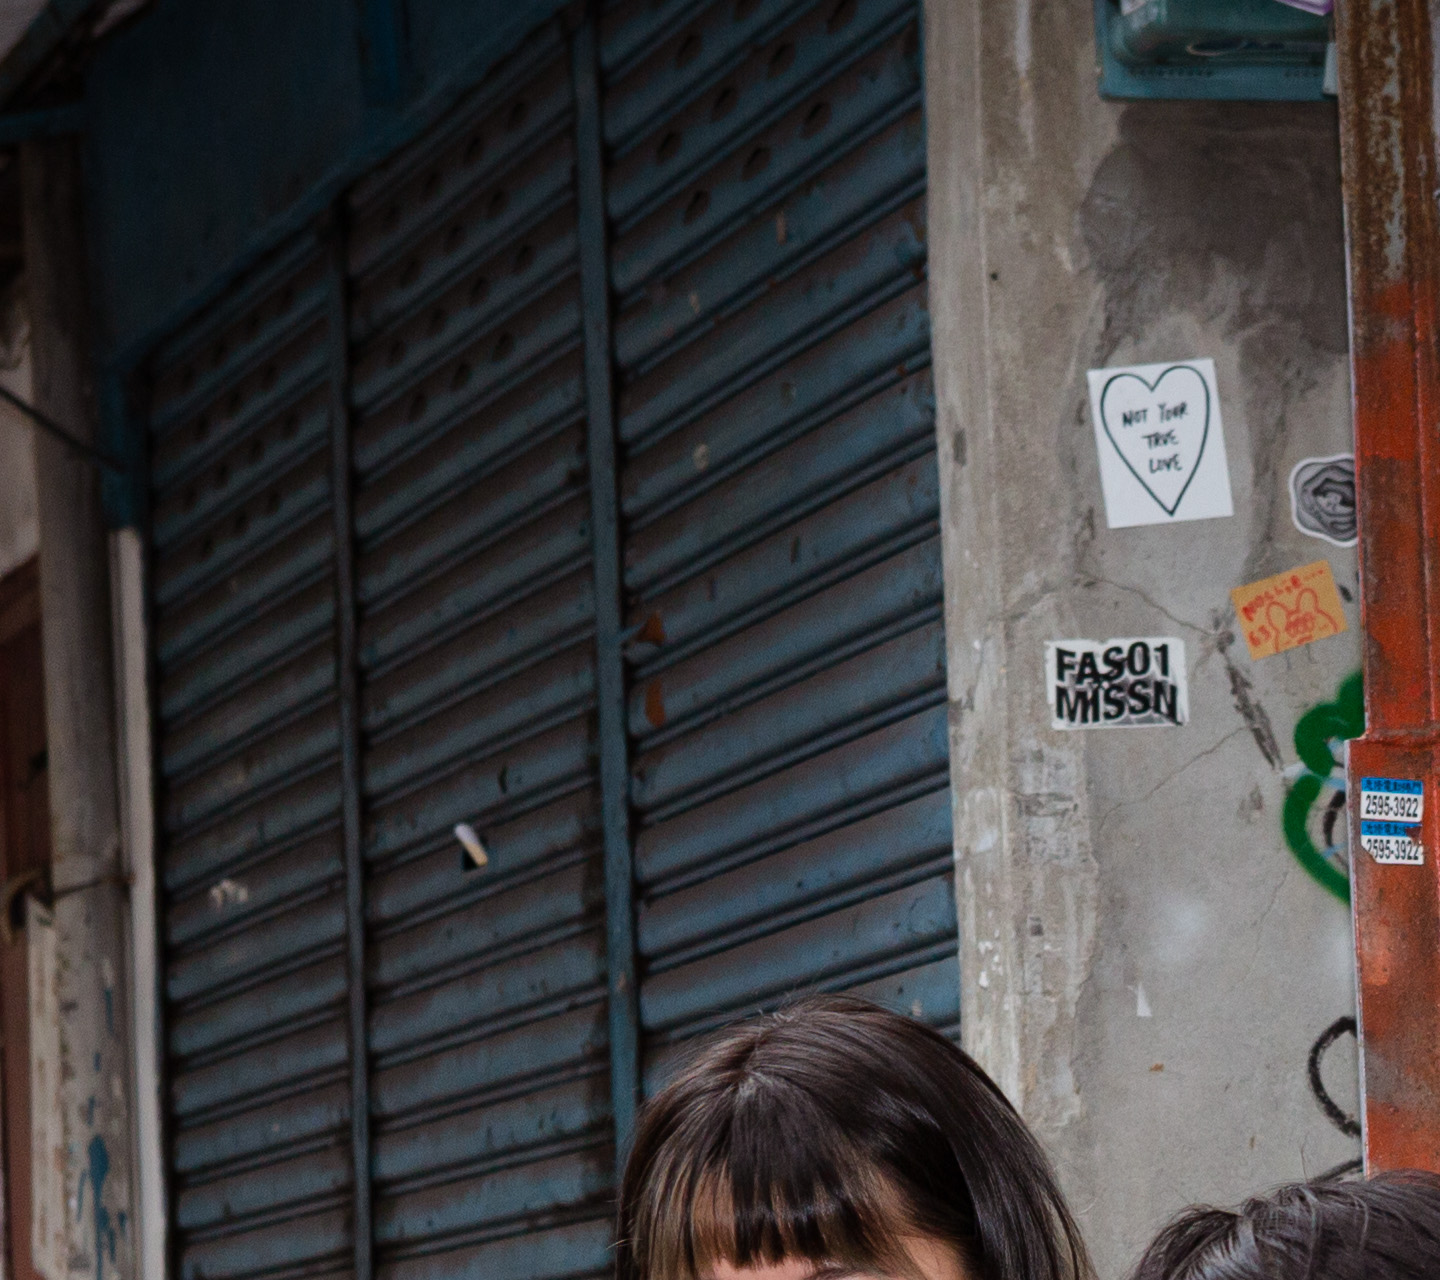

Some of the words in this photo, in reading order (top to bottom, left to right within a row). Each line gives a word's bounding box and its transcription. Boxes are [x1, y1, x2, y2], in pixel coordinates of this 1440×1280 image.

[1122, 409, 1148, 427] NOT
[1158, 402, 1188, 423] YOUR
[1141, 429, 1178, 449] TRUE
[1149, 453, 1183, 474] LOVE
[1056, 681, 1180, 726] MISSN
[1365, 794, 1418, 818] 2595-3922
